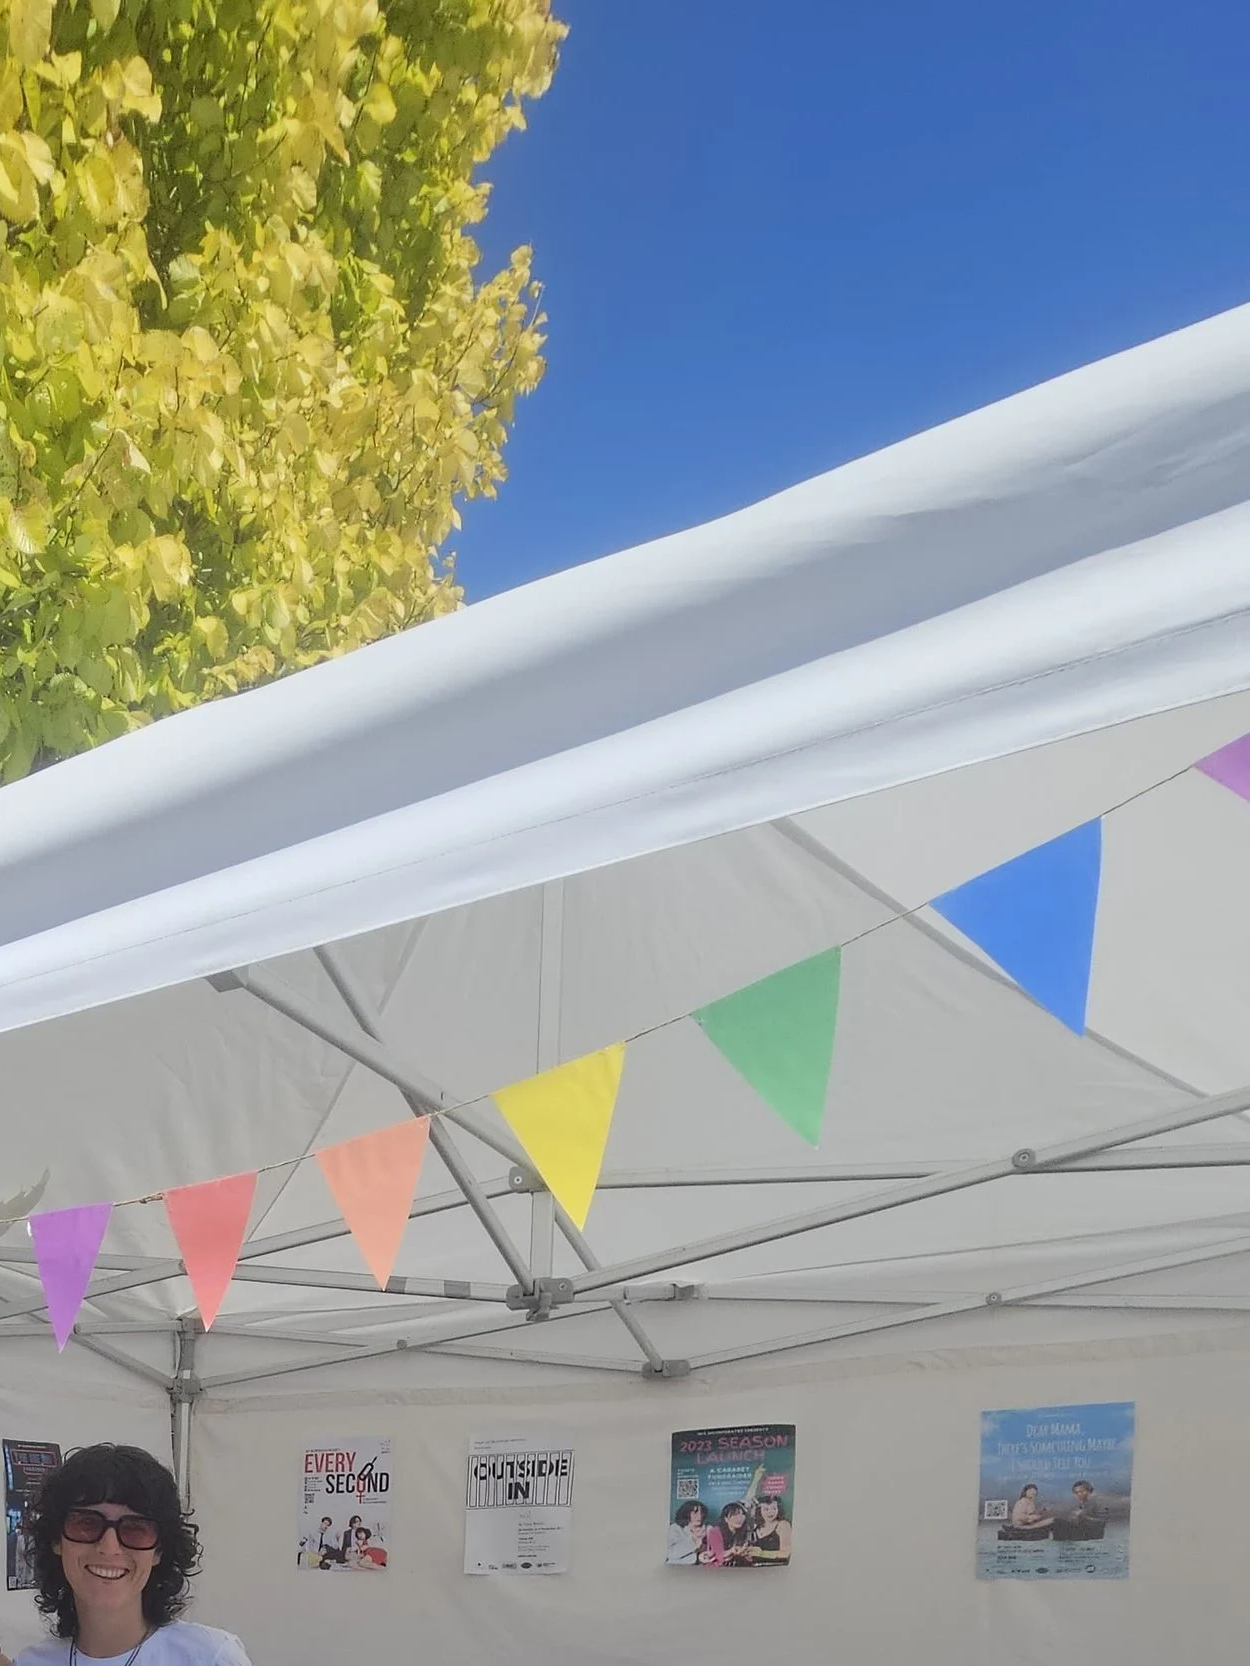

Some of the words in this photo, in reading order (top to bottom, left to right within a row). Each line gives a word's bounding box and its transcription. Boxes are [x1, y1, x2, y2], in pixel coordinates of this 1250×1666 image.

[680, 1440, 713, 1453] 2023
[717, 1435, 789, 1450] SEASON
[304, 1452, 357, 1474] EVERY
[695, 1448, 766, 1465] LAUNCH
[473, 1459, 568, 1481] OUTSIDE
[325, 1470, 390, 1495] SECOND
[507, 1481, 530, 1500] IN
